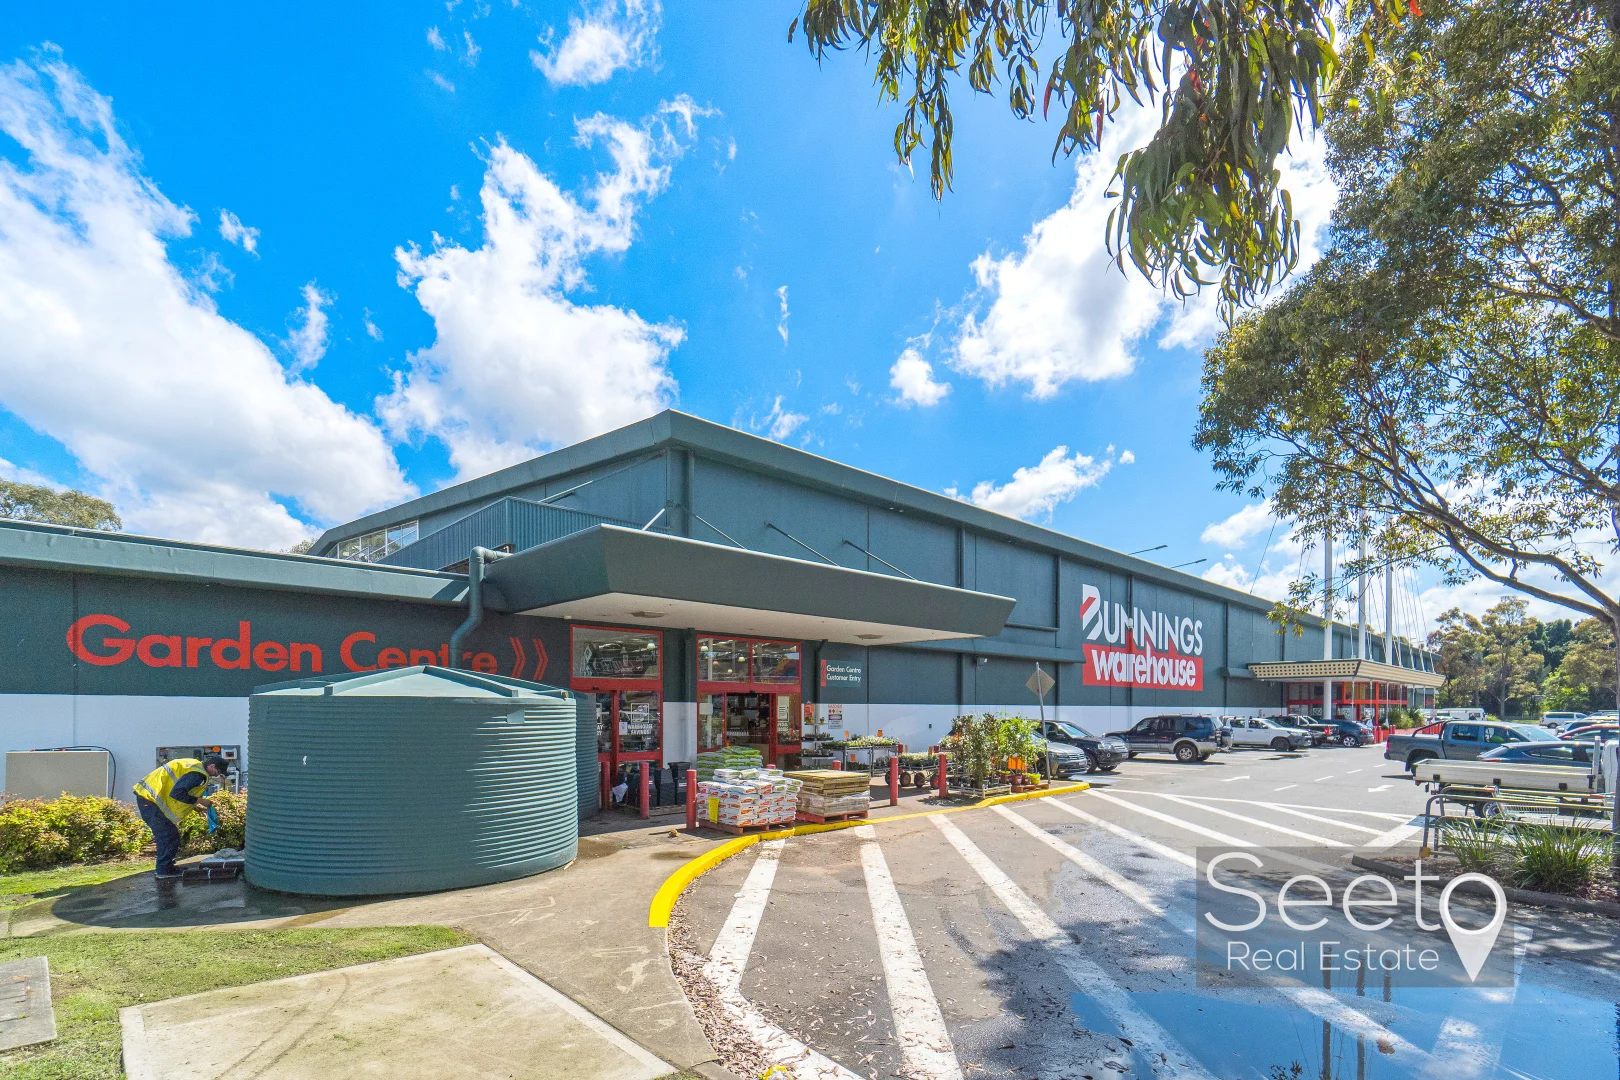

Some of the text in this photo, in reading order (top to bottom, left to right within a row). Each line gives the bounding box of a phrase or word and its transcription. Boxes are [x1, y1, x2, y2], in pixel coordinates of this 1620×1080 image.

[1080, 584, 1203, 655] BUNNINGS
[66, 613, 322, 672] Garden
[1092, 641, 1196, 686] warehouse
[826, 664, 845, 672] Garden
[849, 674, 861, 682] Entry
